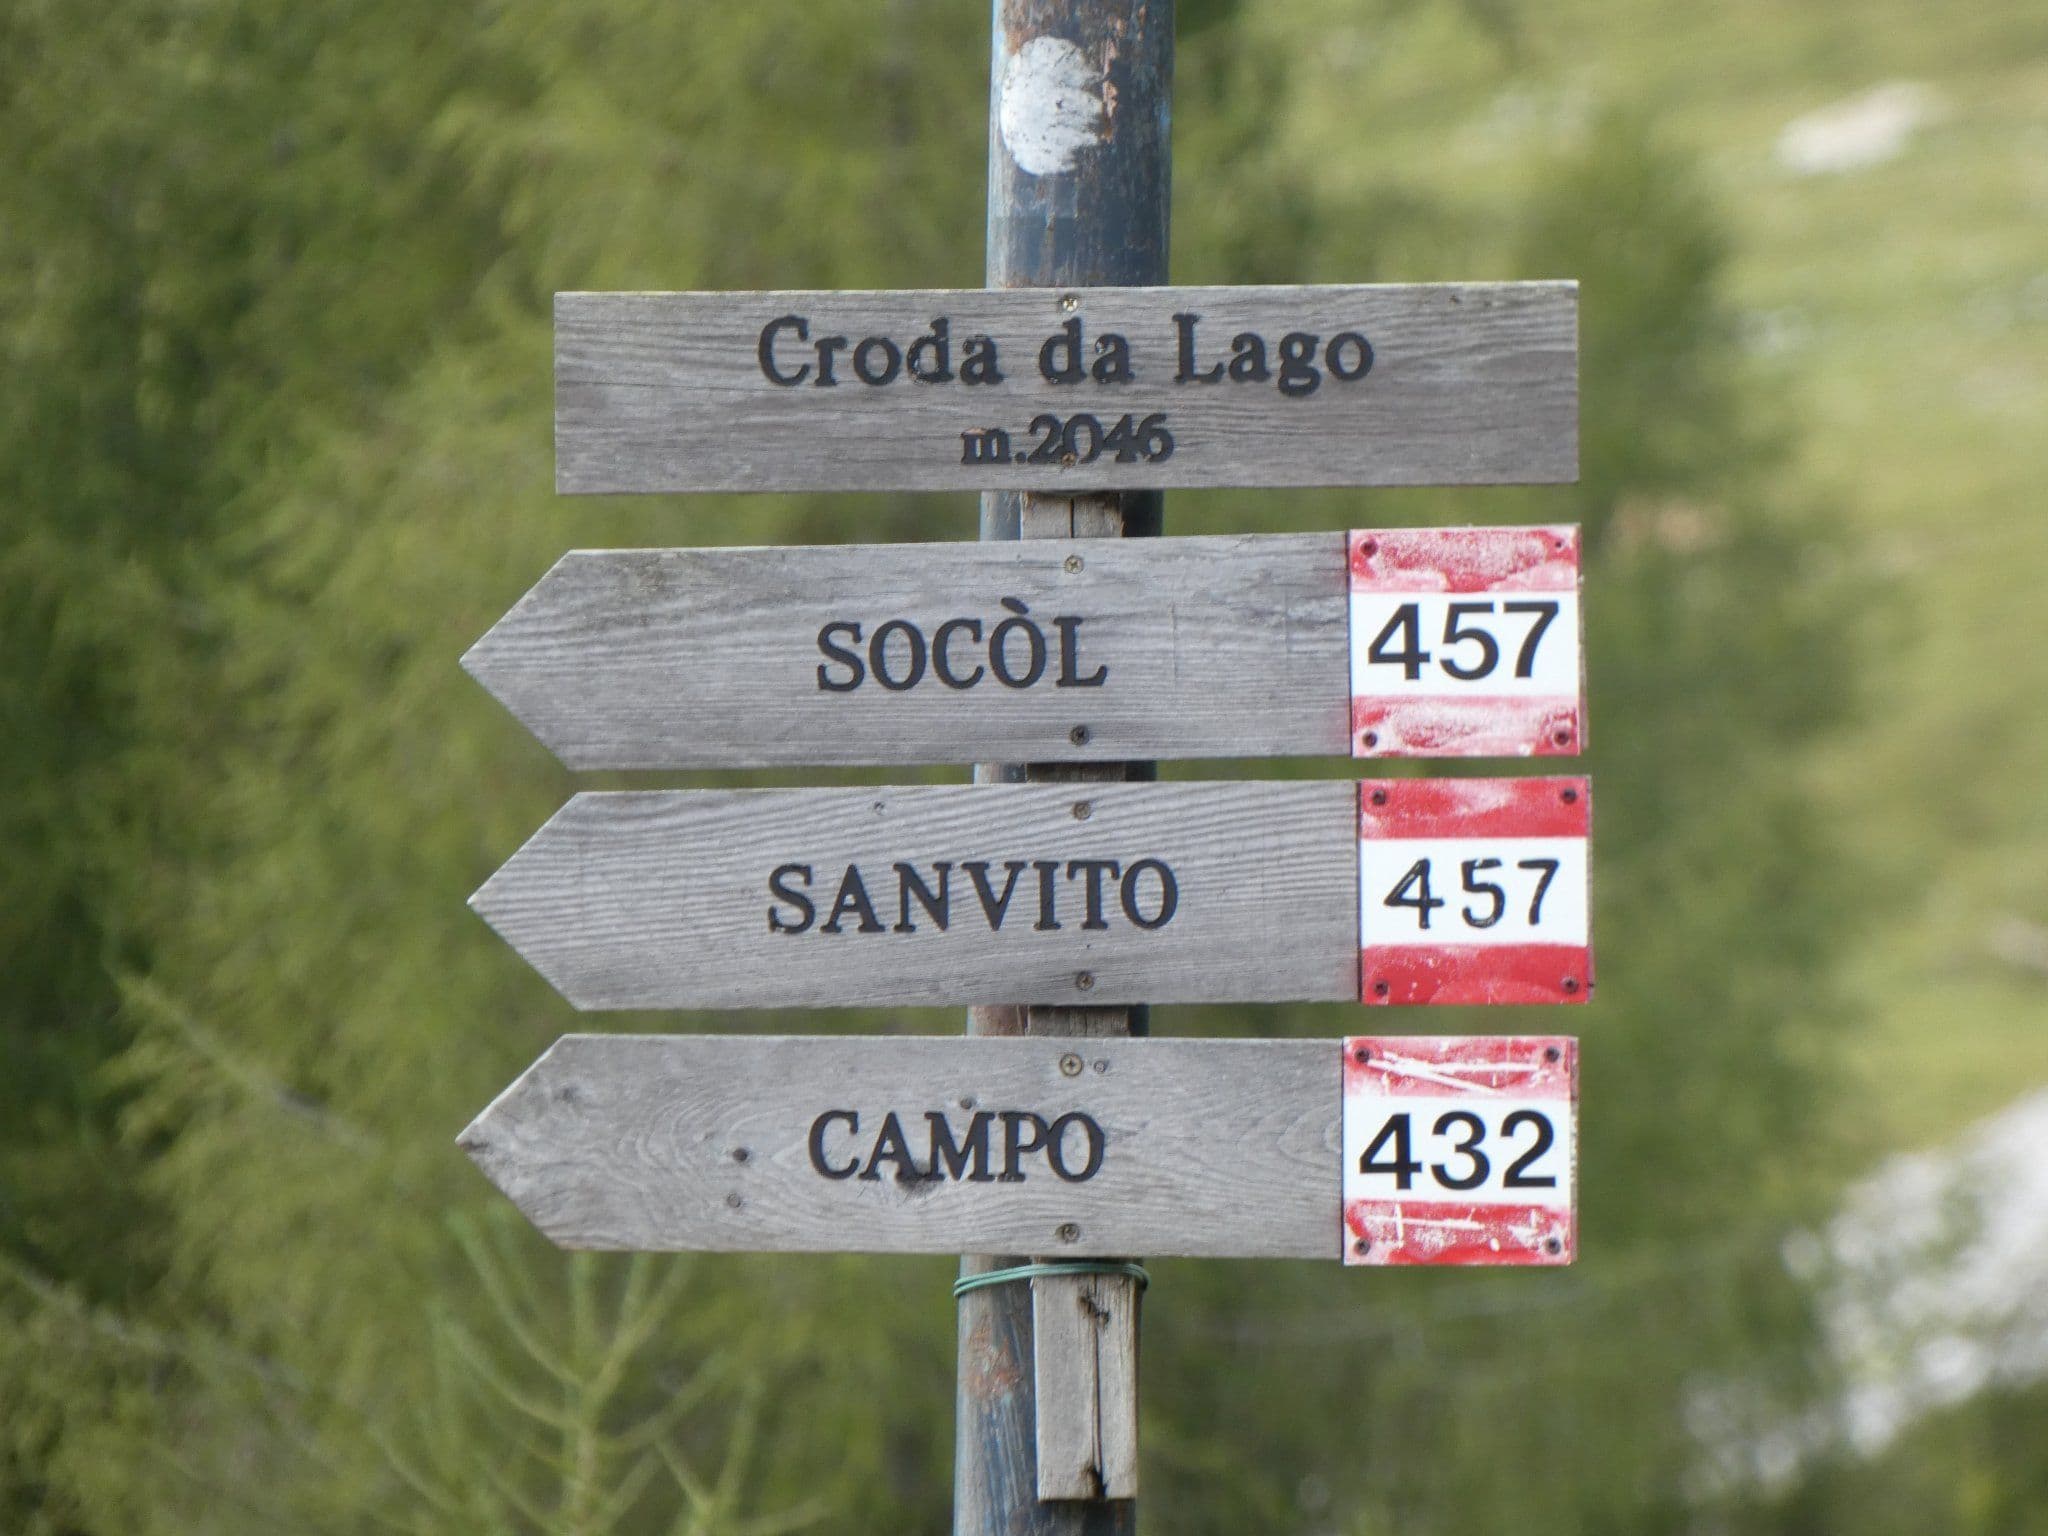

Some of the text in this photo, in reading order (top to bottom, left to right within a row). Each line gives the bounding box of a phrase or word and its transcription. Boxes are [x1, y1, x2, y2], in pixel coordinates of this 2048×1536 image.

[757, 312, 1376, 399] Croda da Lago
[960, 412, 1176, 467] m.2046
[816, 596, 1109, 692] SOCÒL
[1367, 600, 1560, 681] 457
[1383, 857, 1560, 930] 457
[808, 1109, 1107, 1184] CAMPO
[1359, 1109, 1557, 1191] 432
